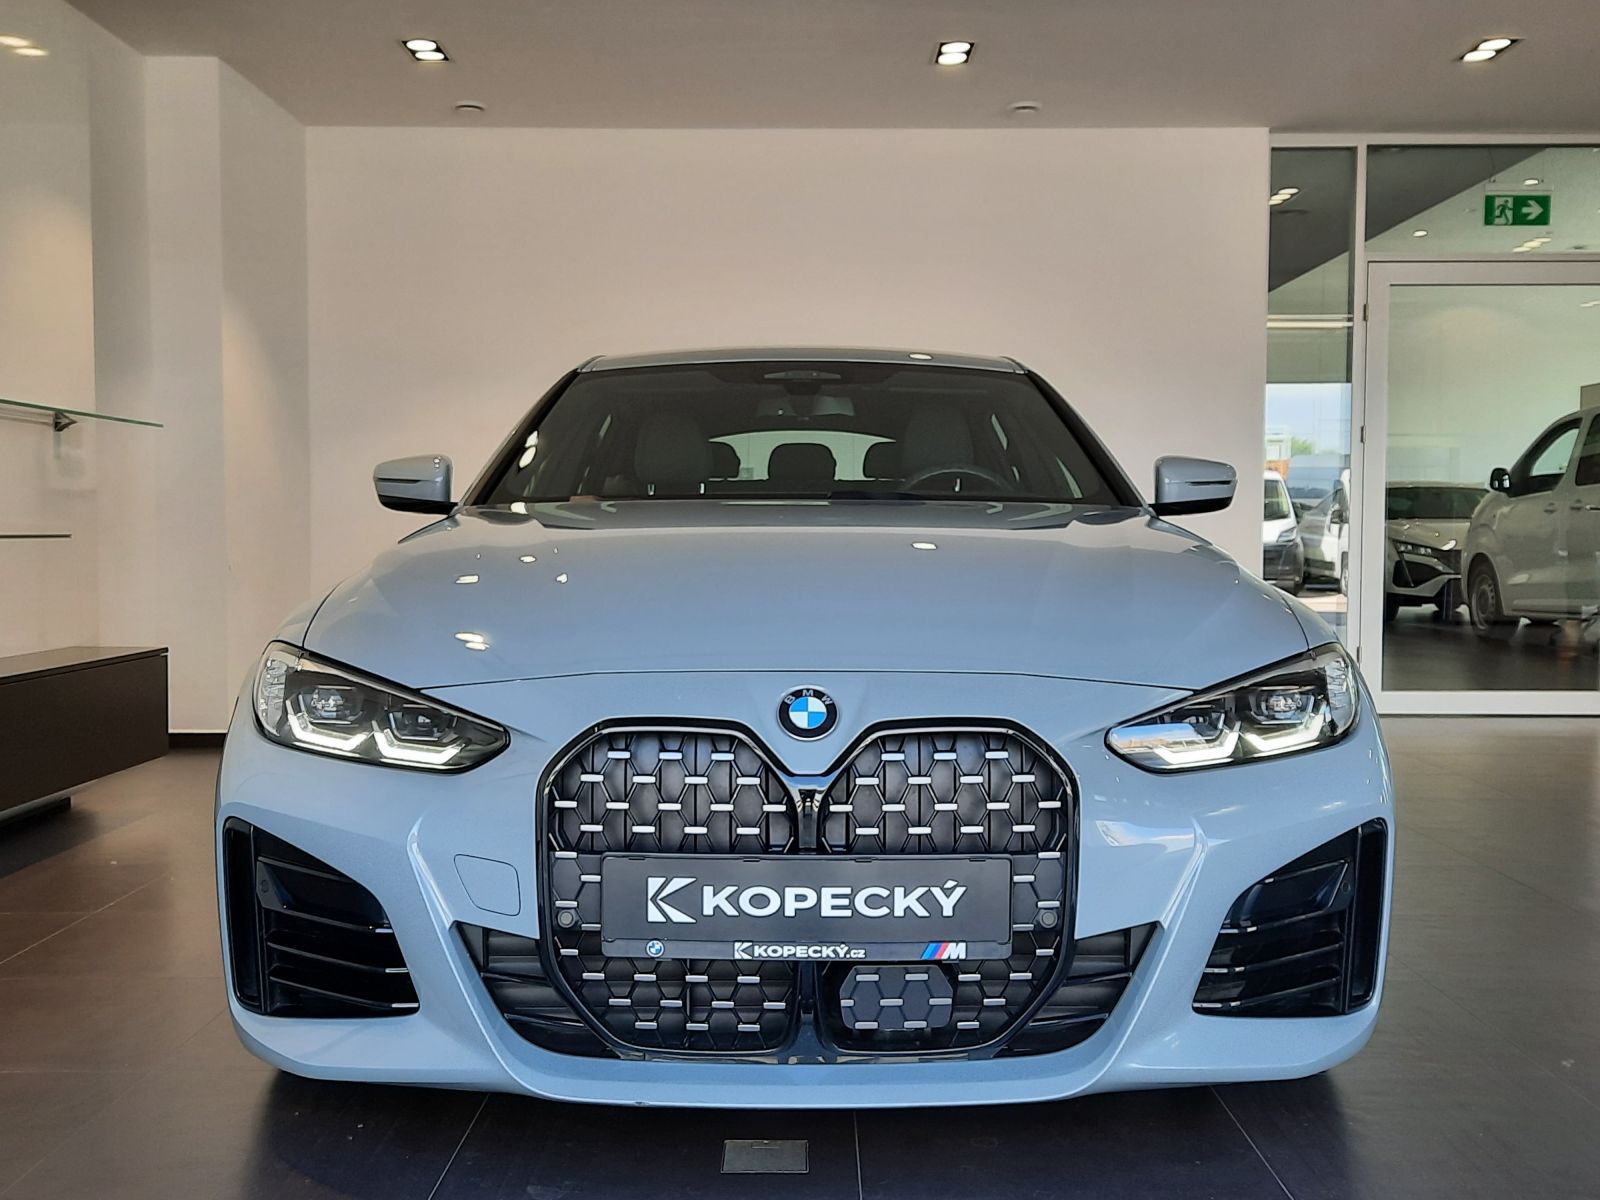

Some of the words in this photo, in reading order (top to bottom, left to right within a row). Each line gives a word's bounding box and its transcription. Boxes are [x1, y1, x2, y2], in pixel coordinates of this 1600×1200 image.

[784, 689, 833, 705] BMW
[702, 880, 967, 918] KOPECKÝ
[754, 944, 866, 959] KOPECKÝ.cz
